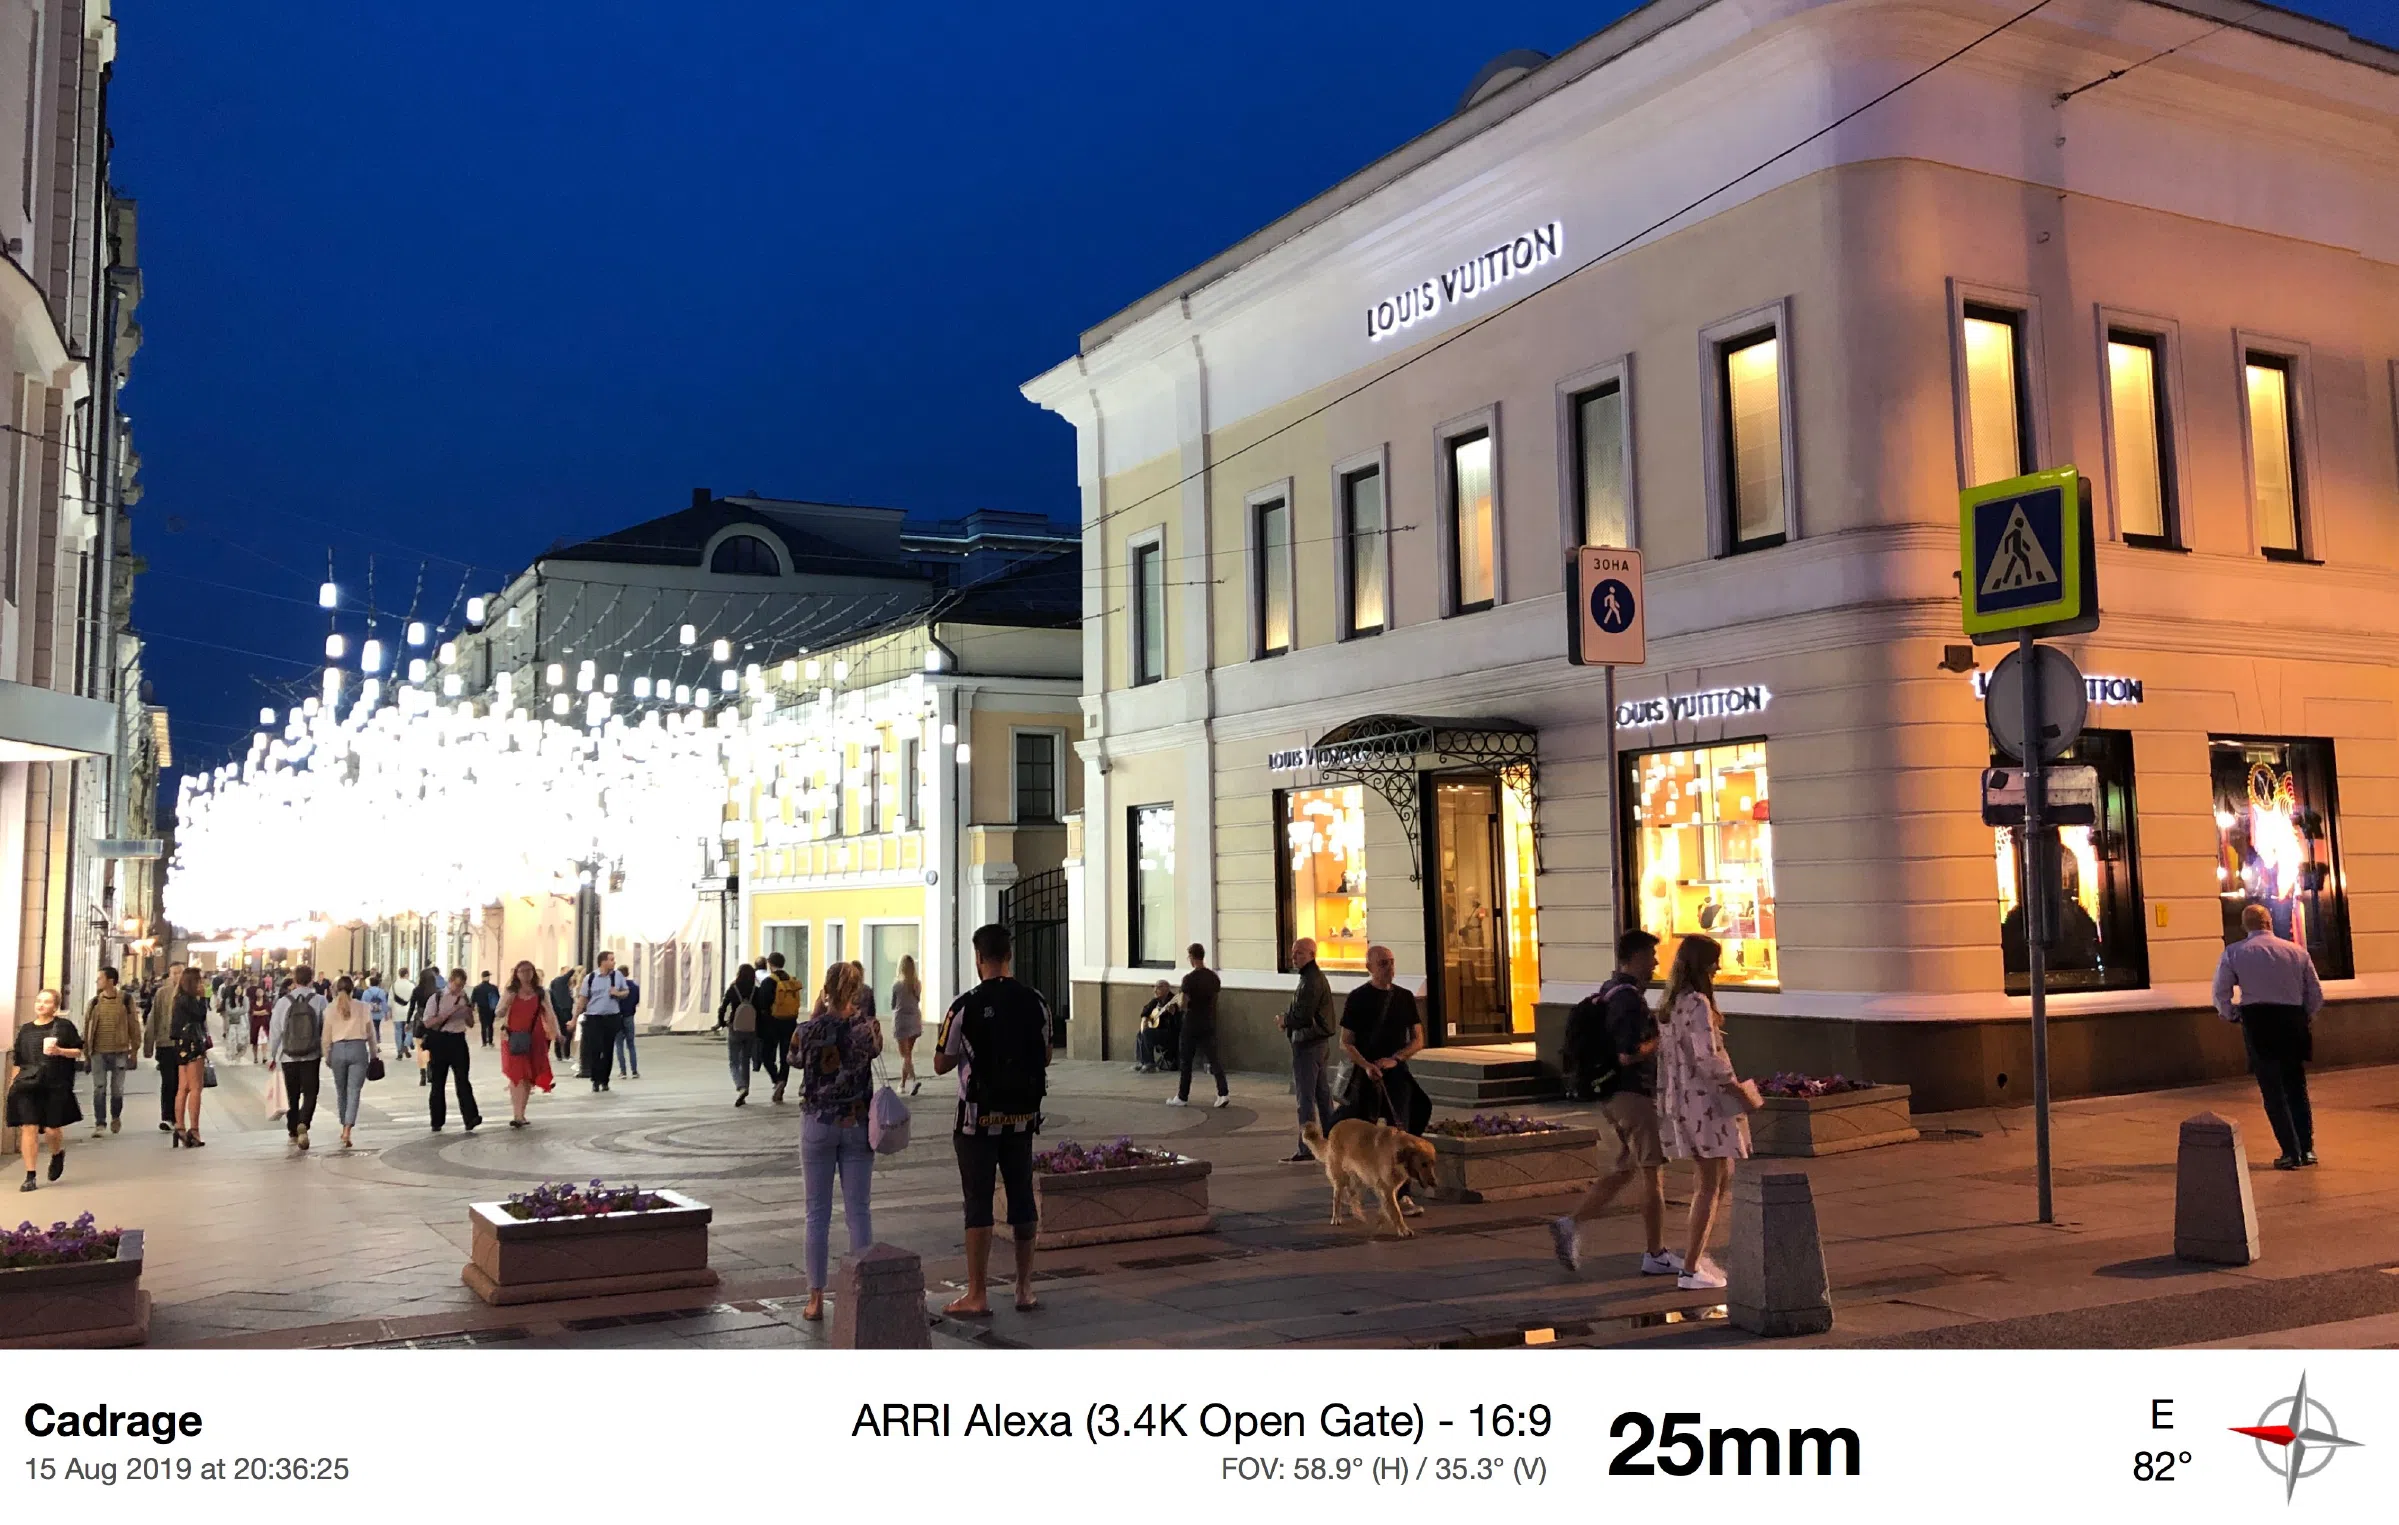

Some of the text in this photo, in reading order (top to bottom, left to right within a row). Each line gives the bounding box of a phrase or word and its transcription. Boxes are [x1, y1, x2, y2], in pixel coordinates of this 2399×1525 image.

[1367, 223, 1557, 337] LOUIS VUITTON
[1593, 558, 1629, 571] ЗОНА
[2083, 678, 2144, 703] TTON
[1616, 687, 1761, 726] OUIS VUITTON
[1268, 750, 1303, 769] LOUIS
